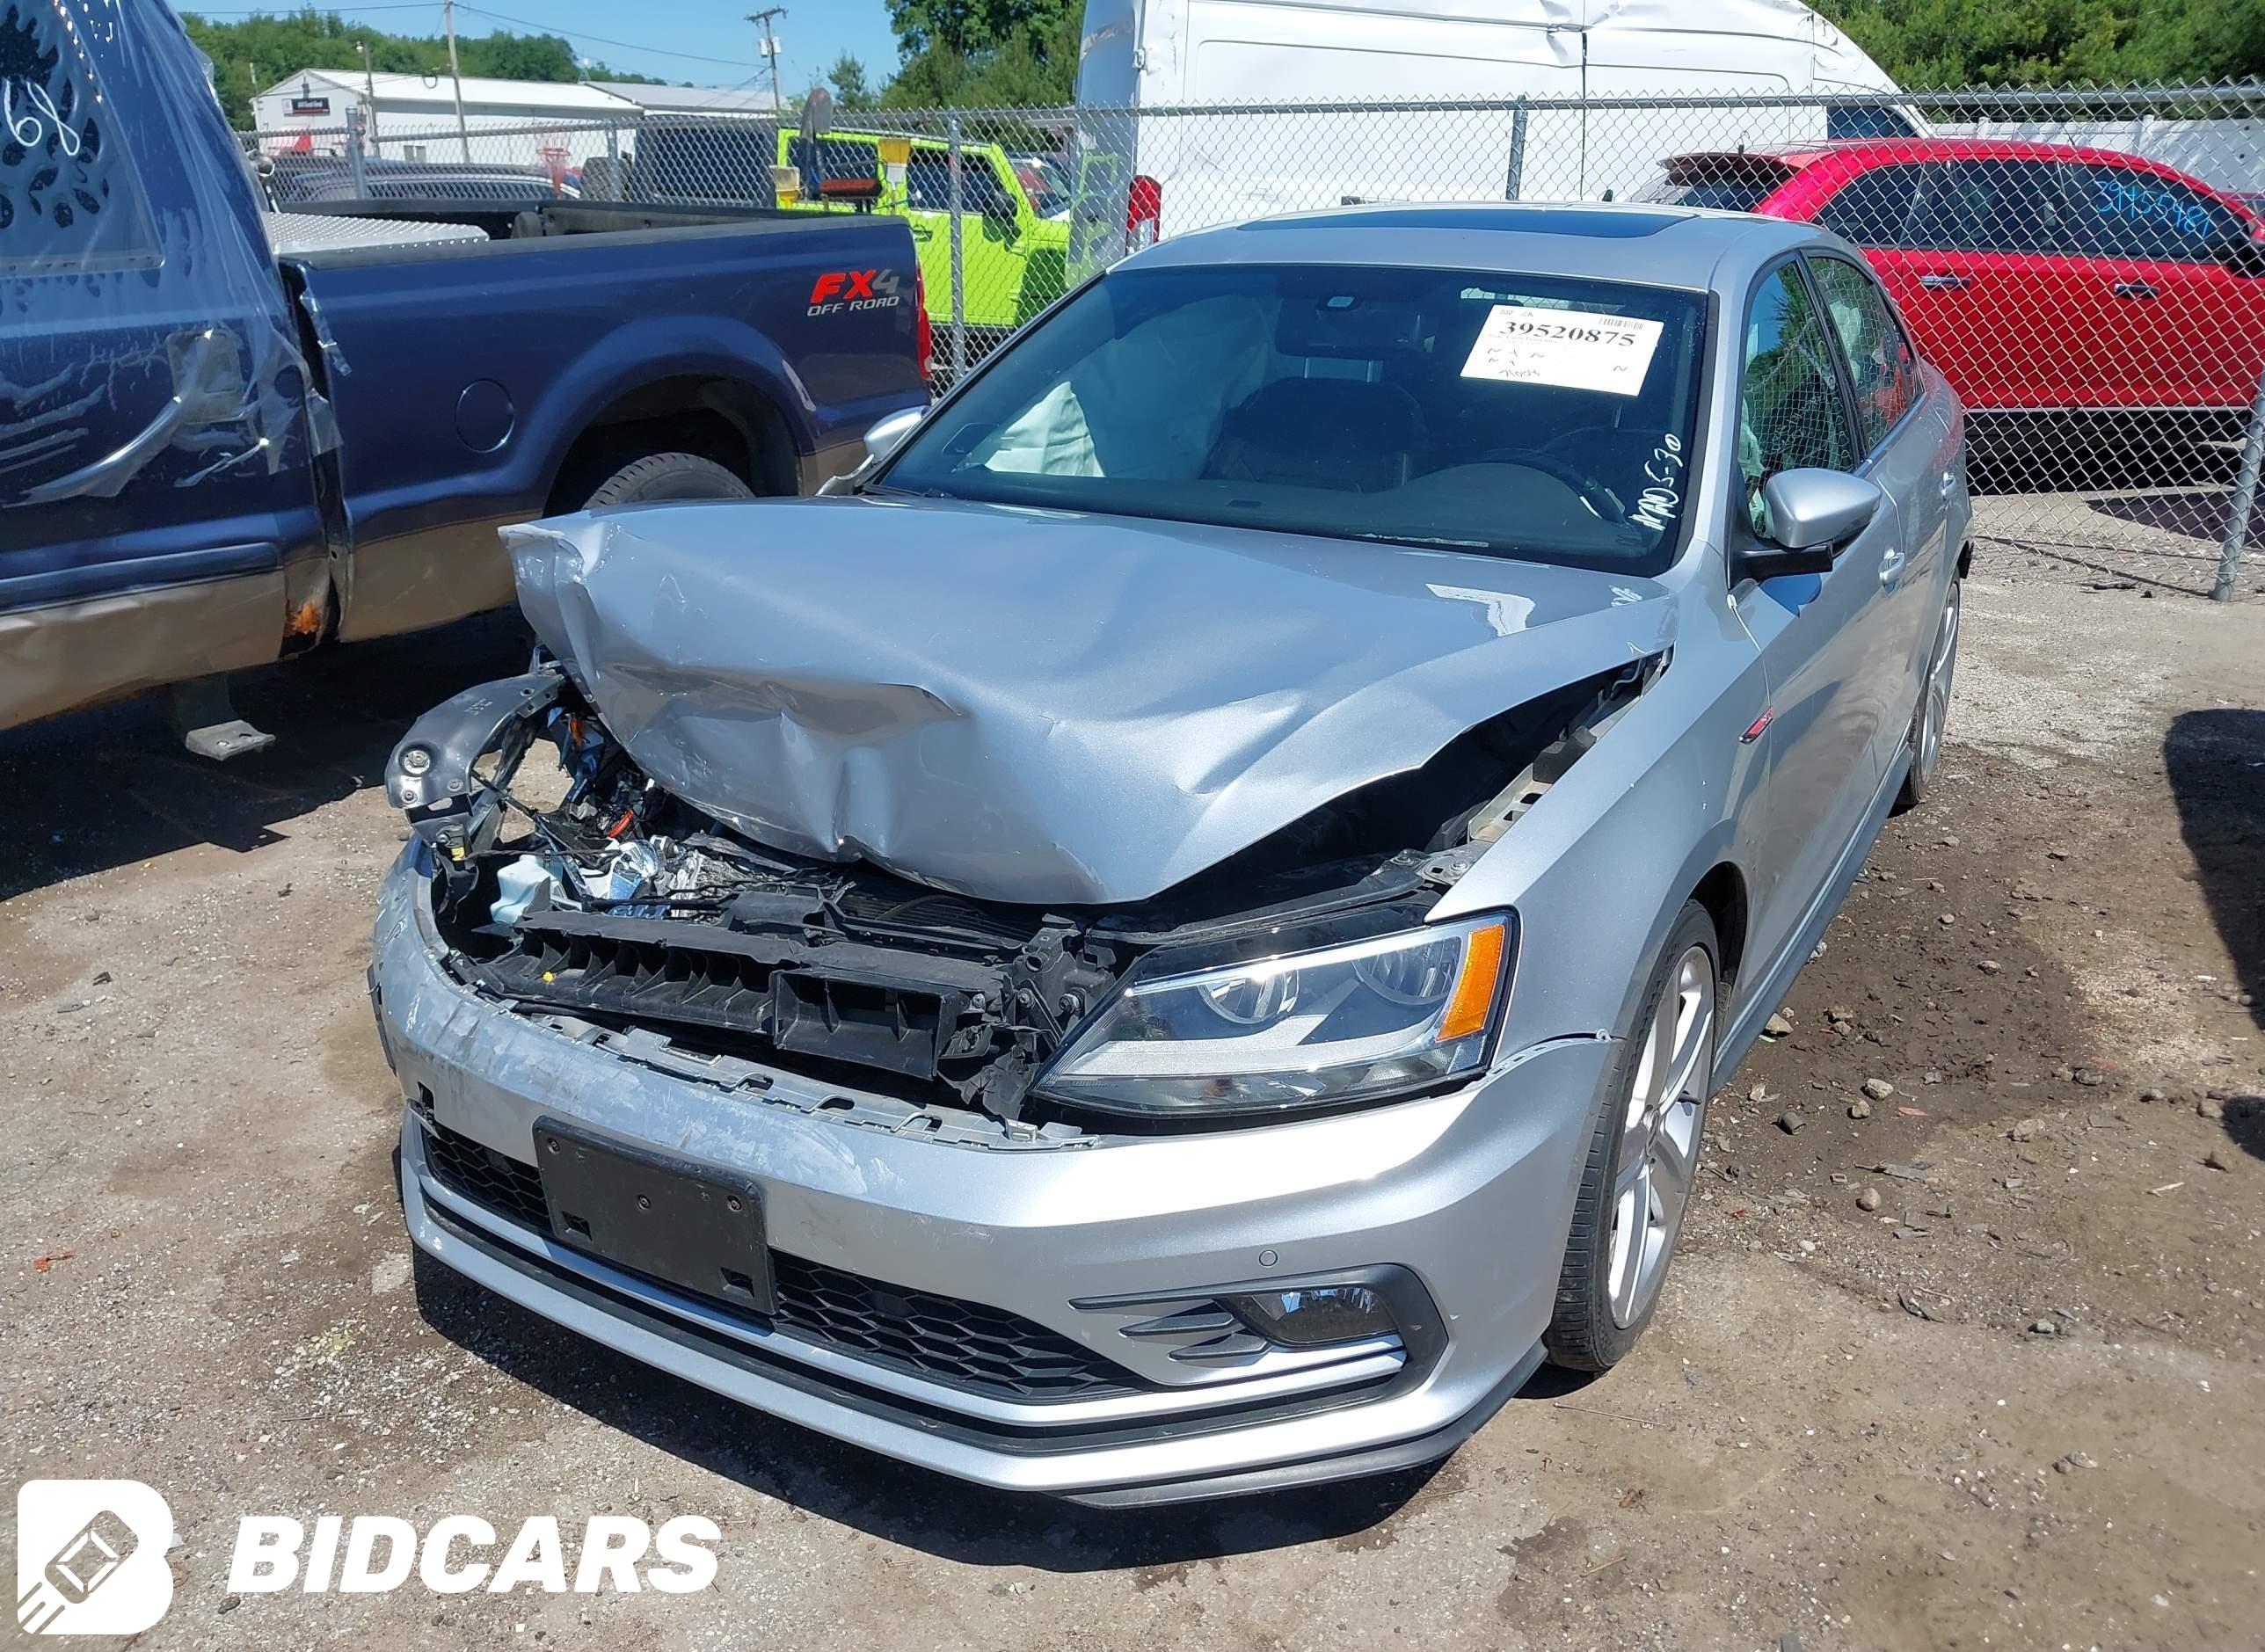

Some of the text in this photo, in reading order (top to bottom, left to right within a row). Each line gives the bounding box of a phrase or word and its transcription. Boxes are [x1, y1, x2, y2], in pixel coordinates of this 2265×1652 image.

[810, 269, 899, 304] FX4
[807, 296, 899, 317] OFF ROAD
[1499, 320, 1636, 347] 39520875
